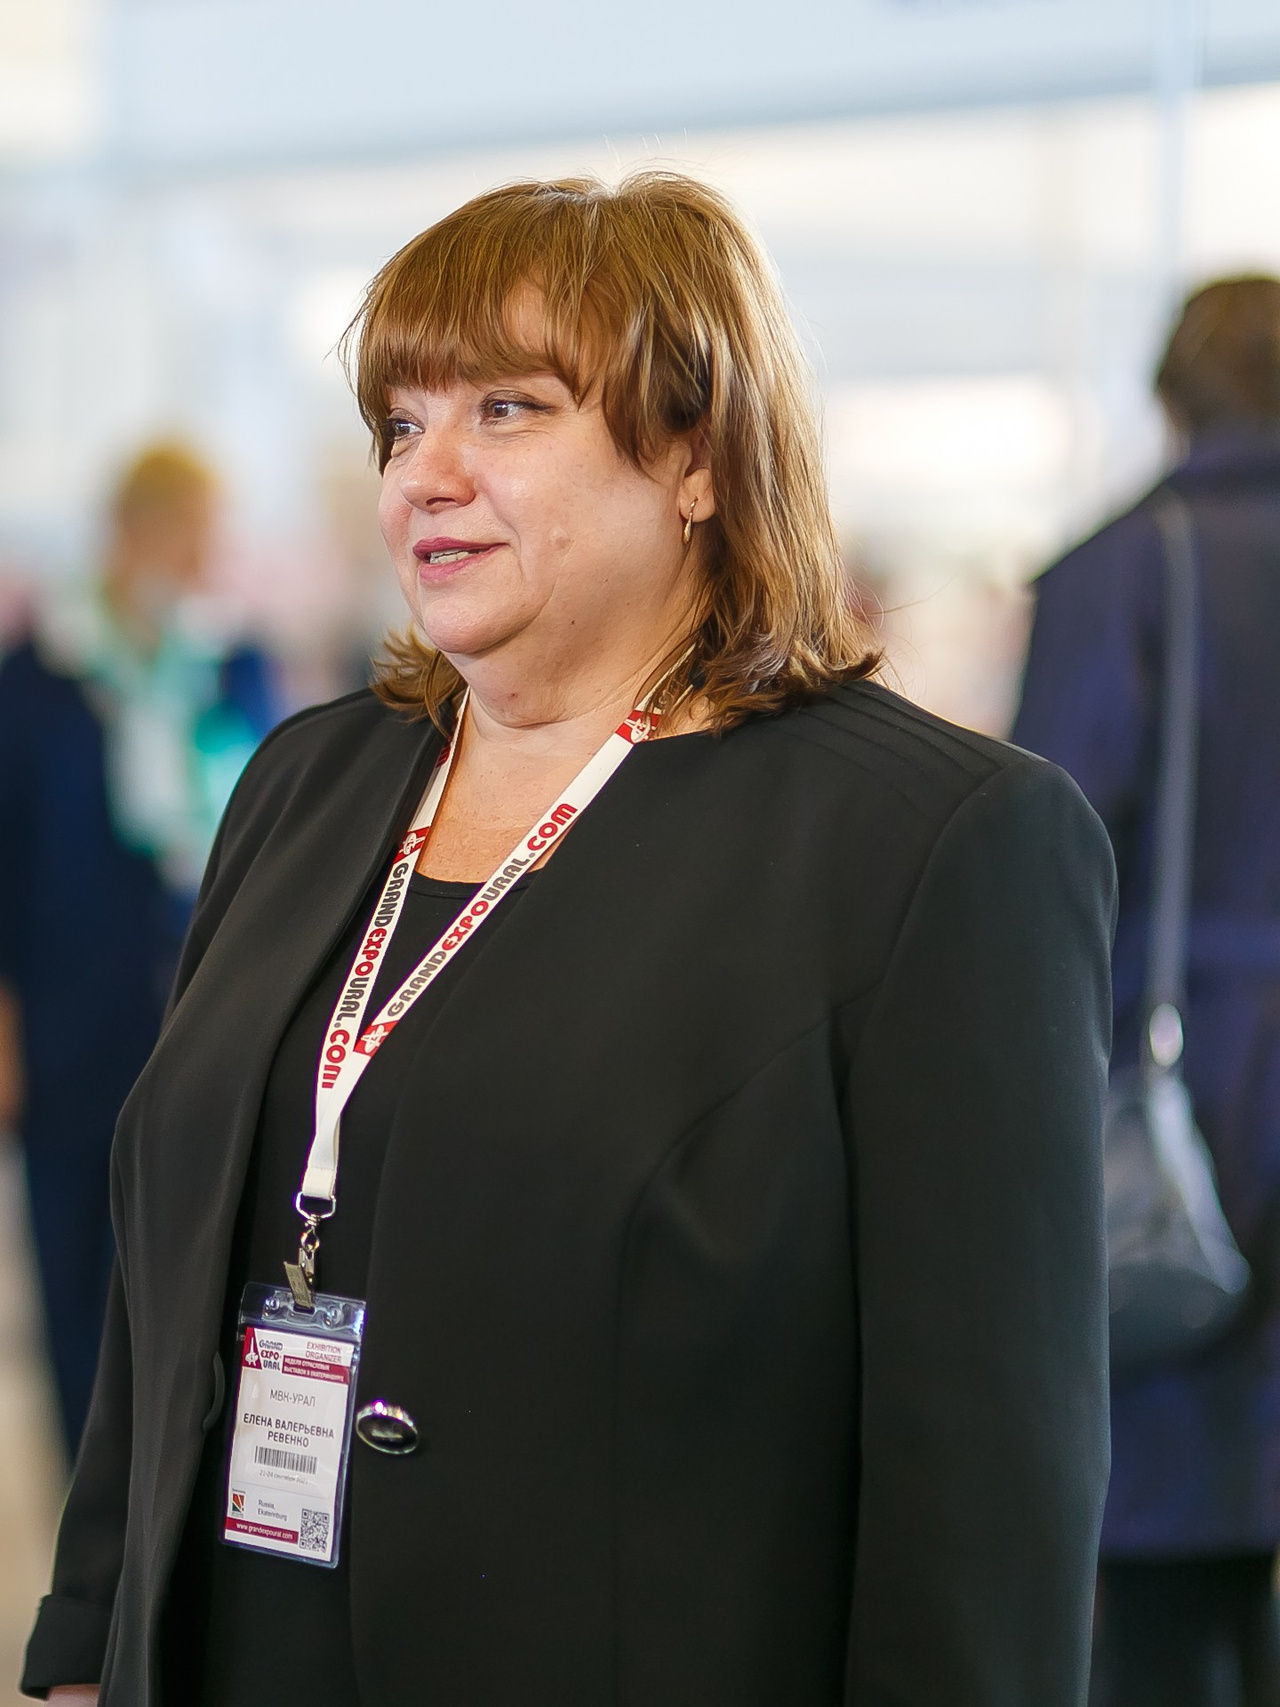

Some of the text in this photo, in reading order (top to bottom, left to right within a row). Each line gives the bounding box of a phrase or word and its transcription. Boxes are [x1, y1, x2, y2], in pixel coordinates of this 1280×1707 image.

[386, 803, 579, 1018] GRANDEXPOURAL.COM
[322, 862, 410, 1089] GRANDEXPOURAL.COM
[305, 1350, 342, 1363] ORGANIZER
[306, 1342, 342, 1354] EXHIBITION
[263, 1360, 281, 1371] URAL
[269, 1389, 316, 1407] МВК-УРАЛ
[243, 1413, 335, 1439] ЕЛЕНА ВАЛЕРЬЕВНА
[267, 1431, 309, 1448] РЕВЕНКО
[257, 1508, 288, 1522] Ekaterinburg
